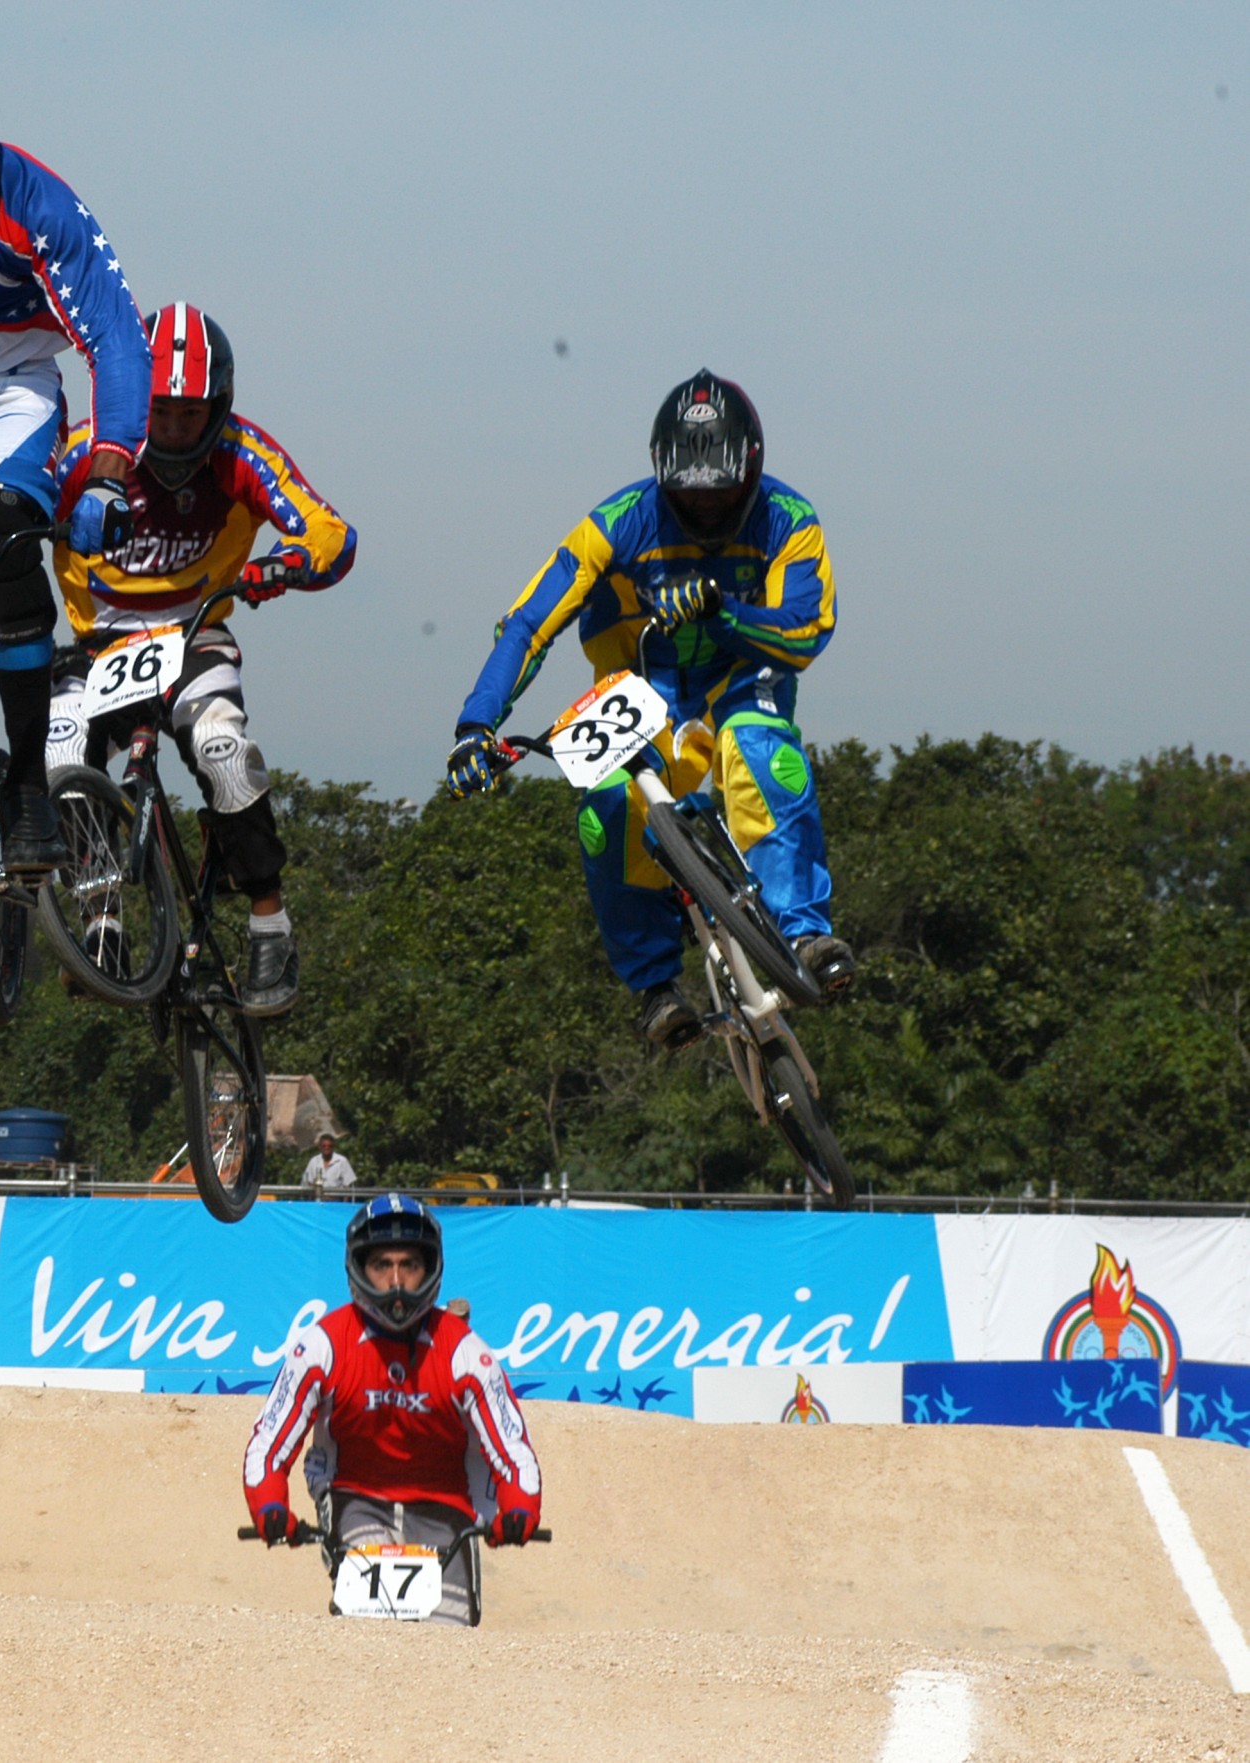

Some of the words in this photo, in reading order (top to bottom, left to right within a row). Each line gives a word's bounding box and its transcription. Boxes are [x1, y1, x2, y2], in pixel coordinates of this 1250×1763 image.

[100, 643, 174, 695] 36
[204, 742, 233, 755] FLY
[571, 694, 642, 762] 33
[31, 1256, 237, 1361] Viva
[360, 1563, 423, 1600] 17
